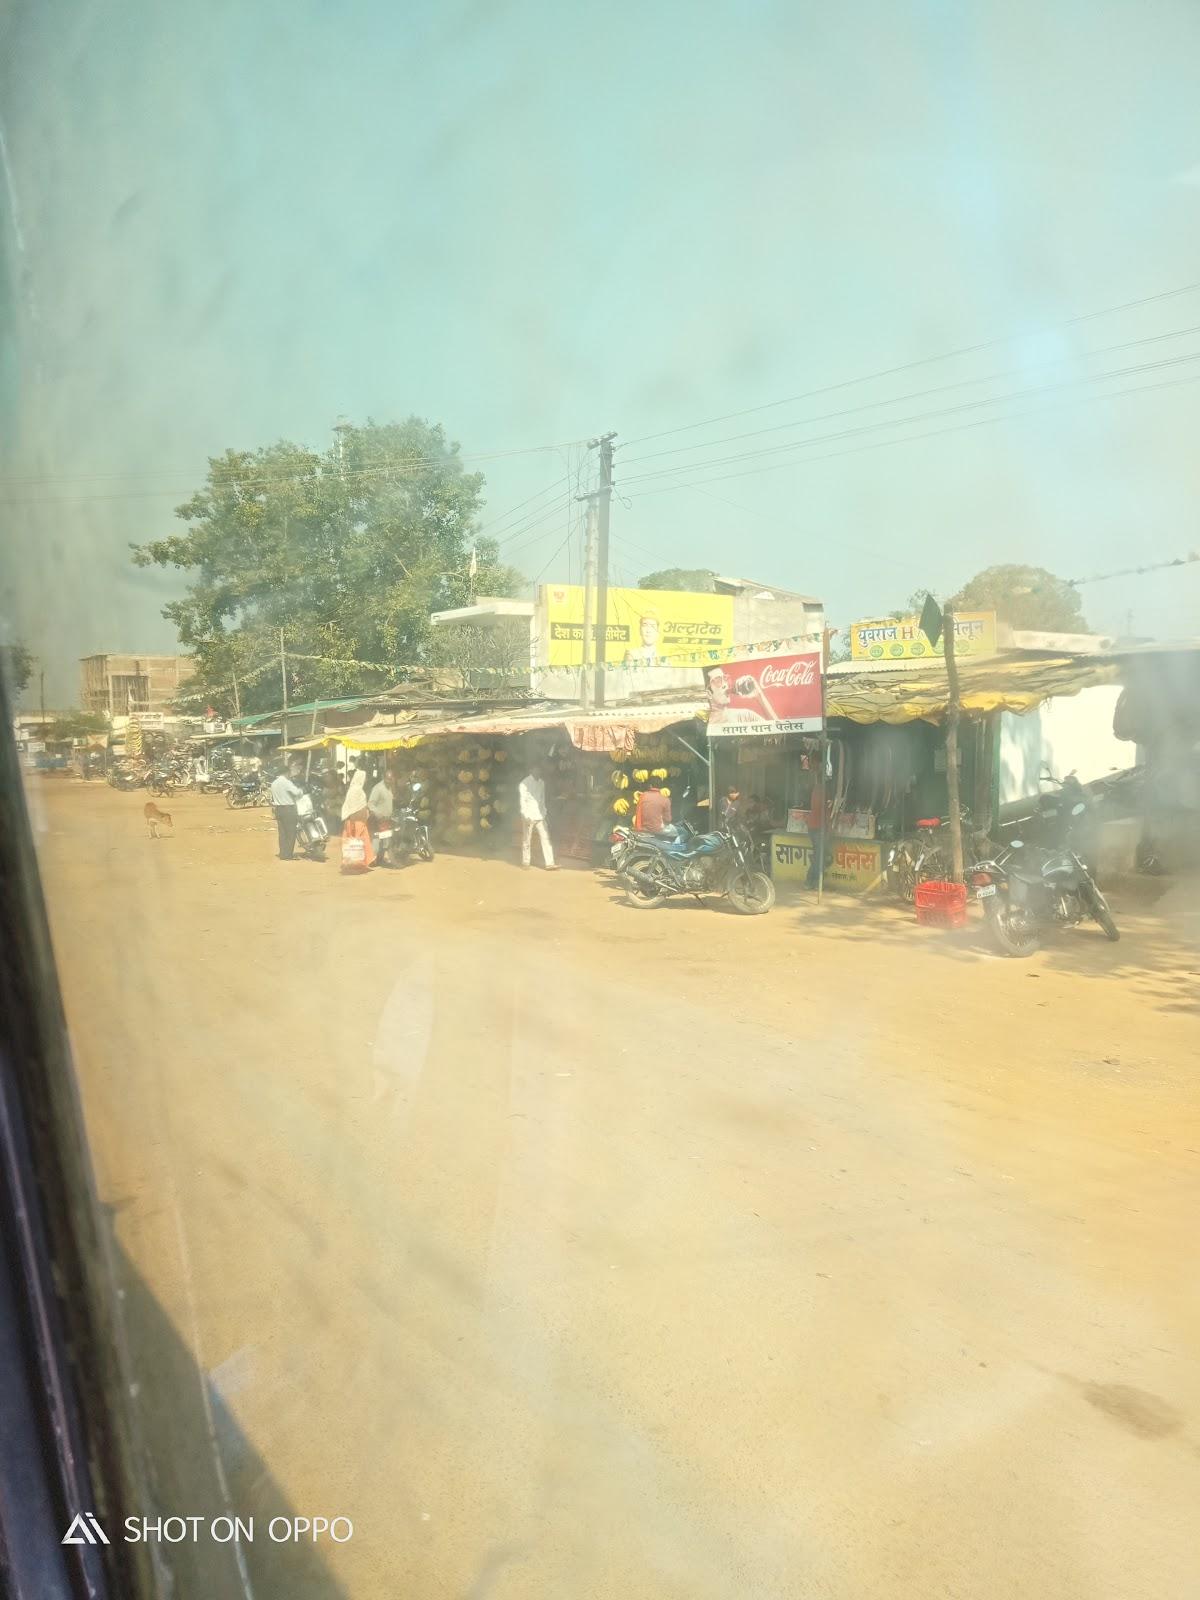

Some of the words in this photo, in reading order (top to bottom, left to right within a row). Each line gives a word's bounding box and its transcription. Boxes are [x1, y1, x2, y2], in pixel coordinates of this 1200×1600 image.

[554, 624, 570, 640] देश
[663, 621, 721, 635] अल्ट्राटेक
[857, 627, 898, 648] युवराज
[722, 725, 748, 735] सागर
[751, 723, 772, 732] पान
